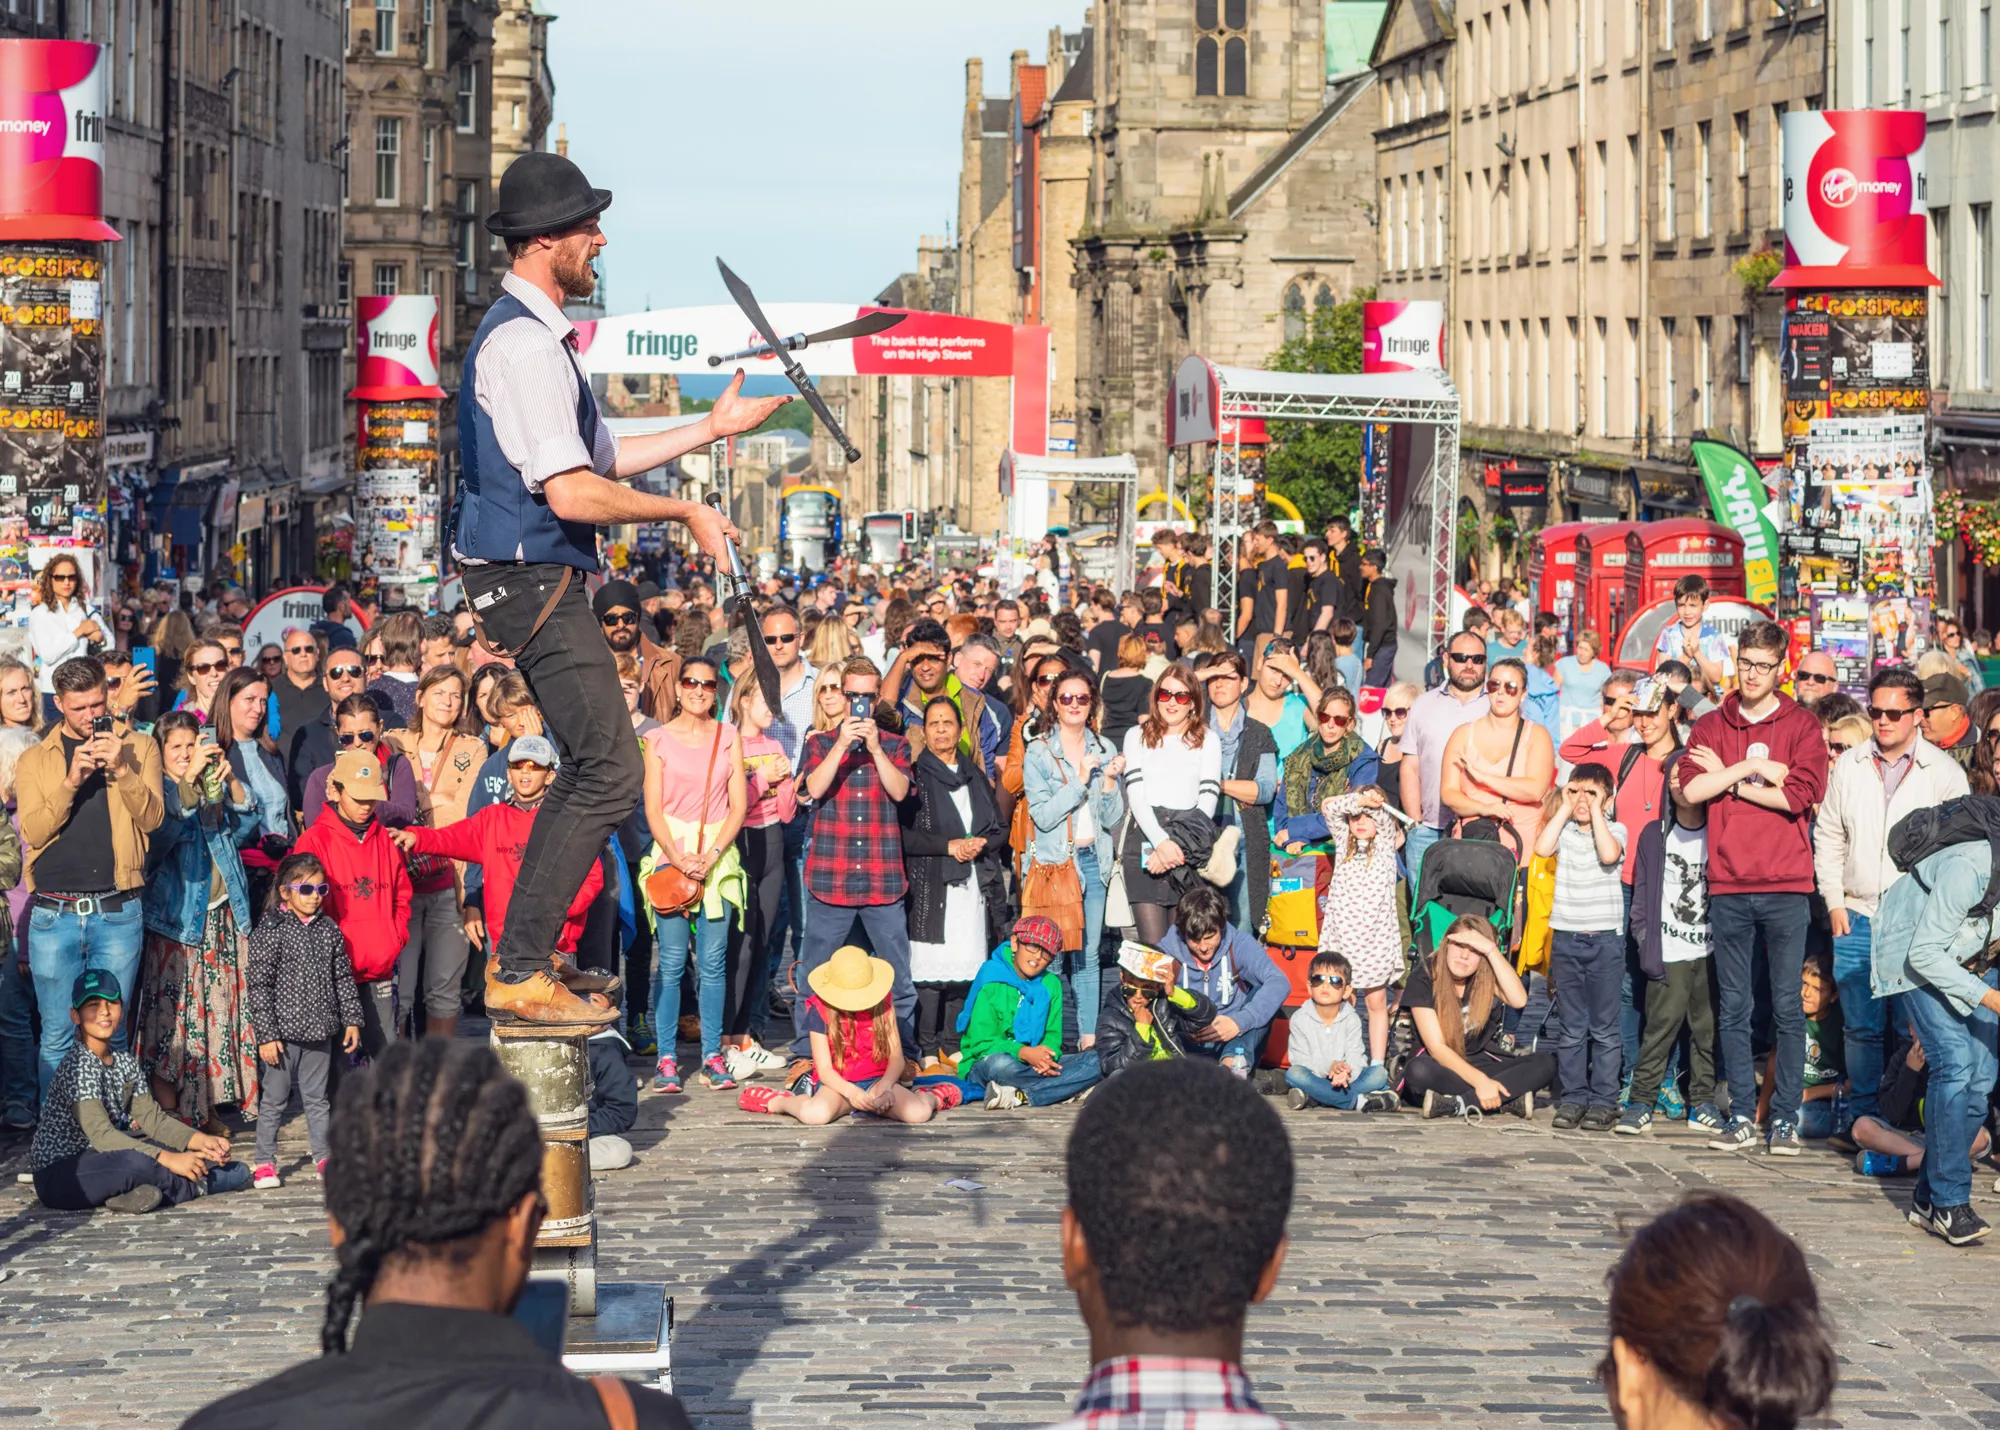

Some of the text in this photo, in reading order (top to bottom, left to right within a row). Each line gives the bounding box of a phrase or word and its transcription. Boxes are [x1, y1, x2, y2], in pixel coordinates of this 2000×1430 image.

[1858, 181, 1902, 196] money
[1828, 298, 1891, 316] GOSSIP
[374, 330, 417, 351] fringe
[626, 330, 698, 361] fringe
[871, 335, 986, 350] The bank that performs
[1387, 335, 1430, 356] fringe
[883, 350, 973, 363] on the High Street
[1830, 389, 1893, 408] GOSSIP
[1657, 554, 1731, 566] TELEPHONE
[282, 600, 327, 621] fring
